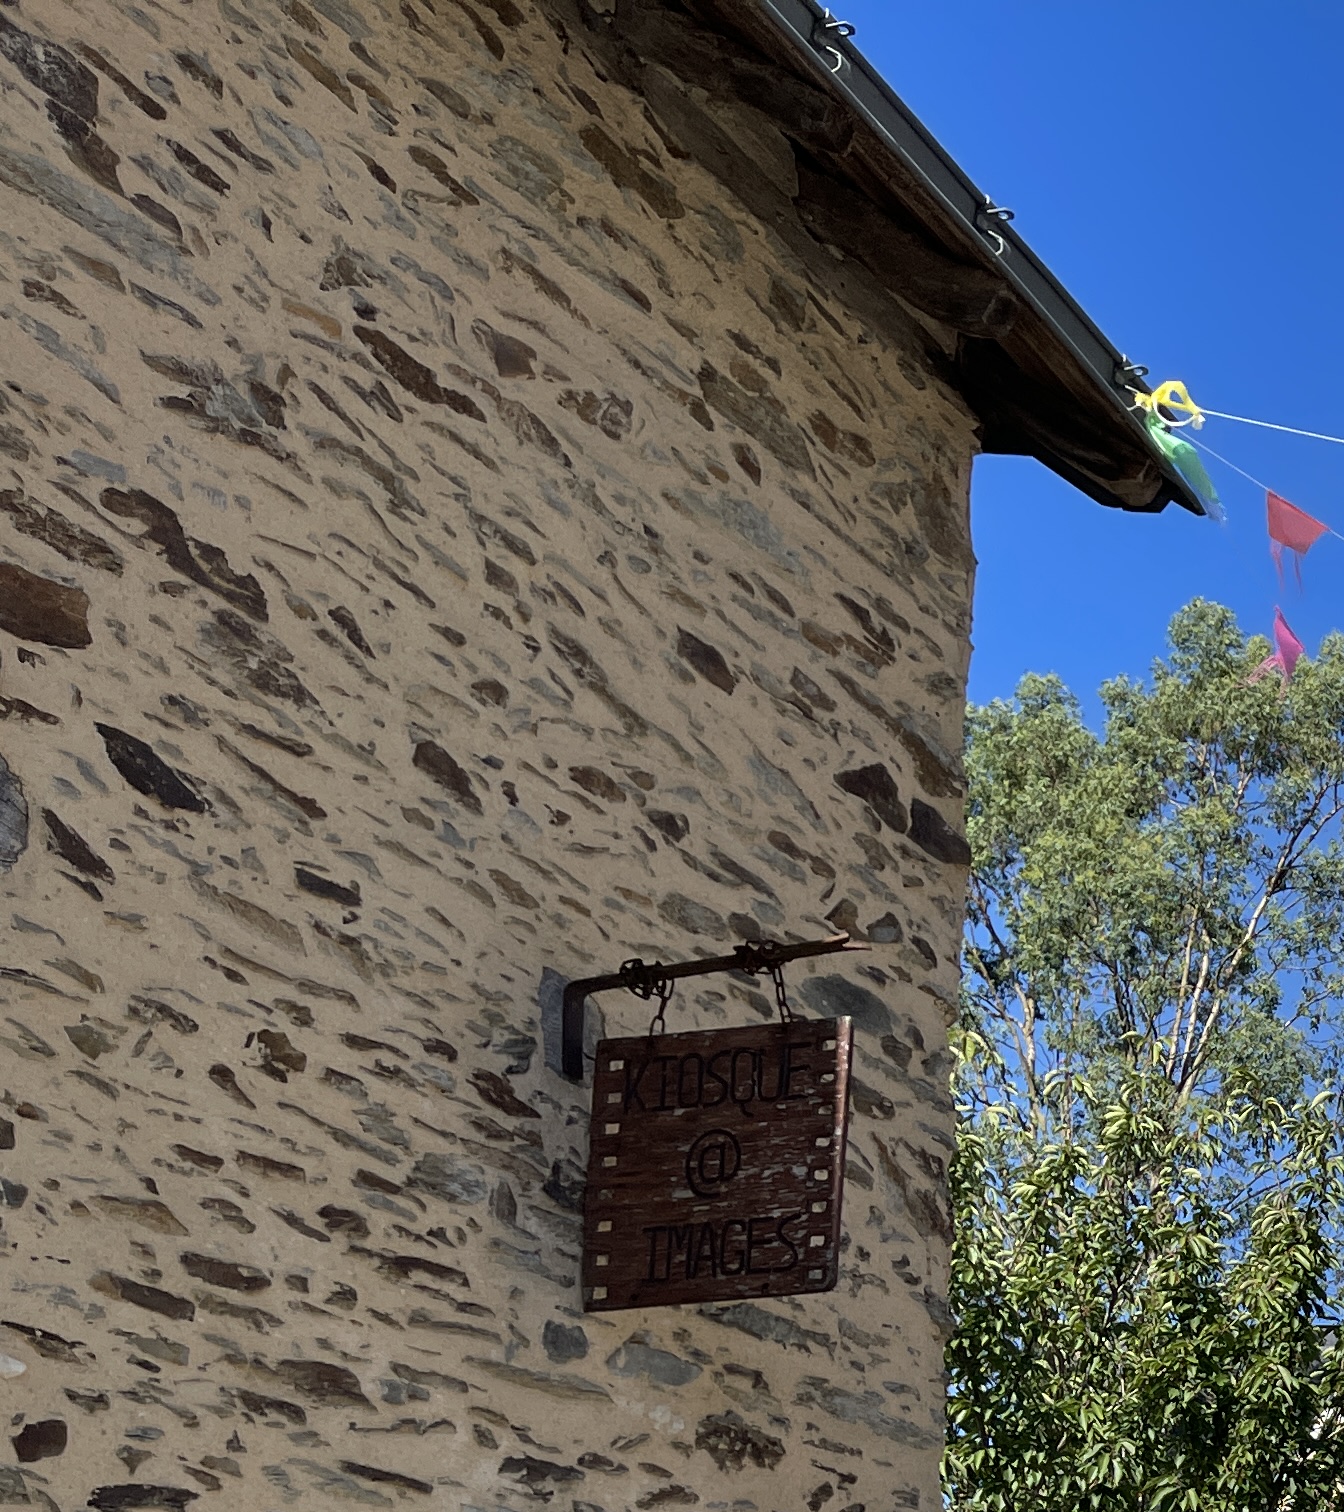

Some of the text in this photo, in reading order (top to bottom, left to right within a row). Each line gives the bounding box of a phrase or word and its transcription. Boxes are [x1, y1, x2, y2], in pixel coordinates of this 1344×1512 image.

[623, 1042, 813, 1117] KIOSQUE
[685, 1128, 742, 1198] @
[642, 1213, 803, 1283] IMAGES
